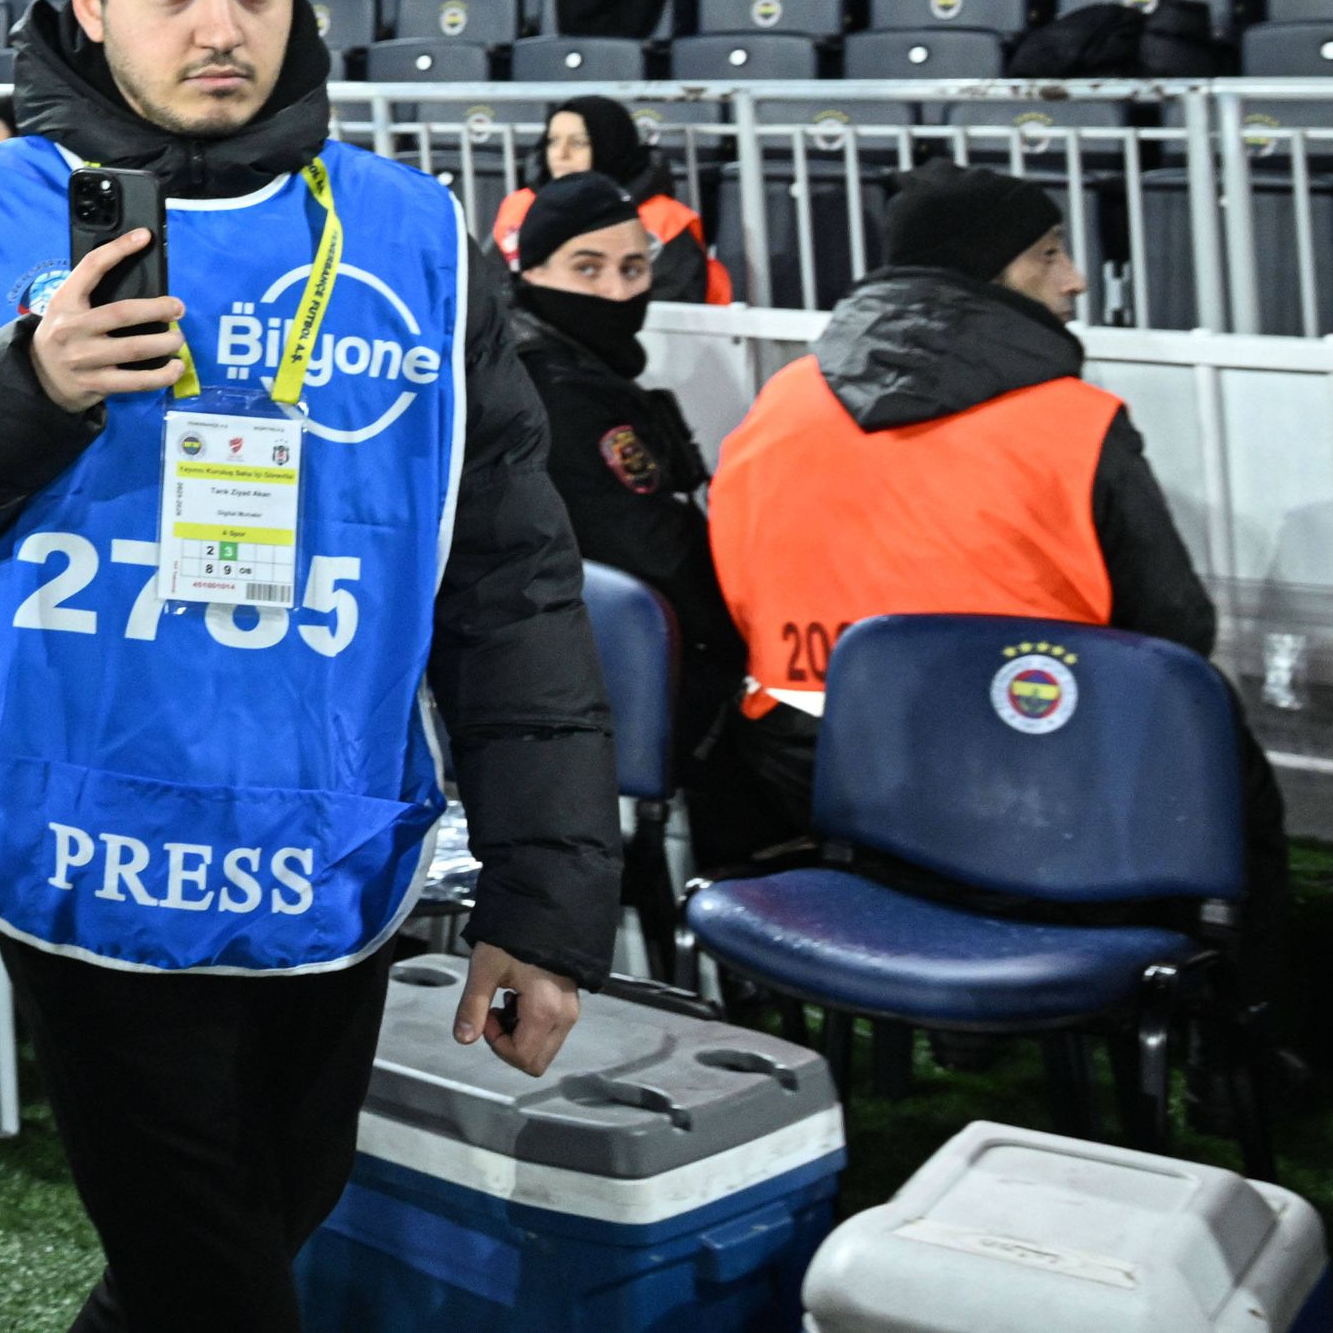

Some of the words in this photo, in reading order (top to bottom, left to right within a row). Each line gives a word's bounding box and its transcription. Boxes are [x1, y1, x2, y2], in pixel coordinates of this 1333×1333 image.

[205, 564, 214, 574] 8
[223, 565, 232, 575] 9
[206, 545, 214, 556] 2
[224, 546, 234, 557] 3
[781, 621, 853, 683] 20
[47, 822, 316, 916] PRESS
